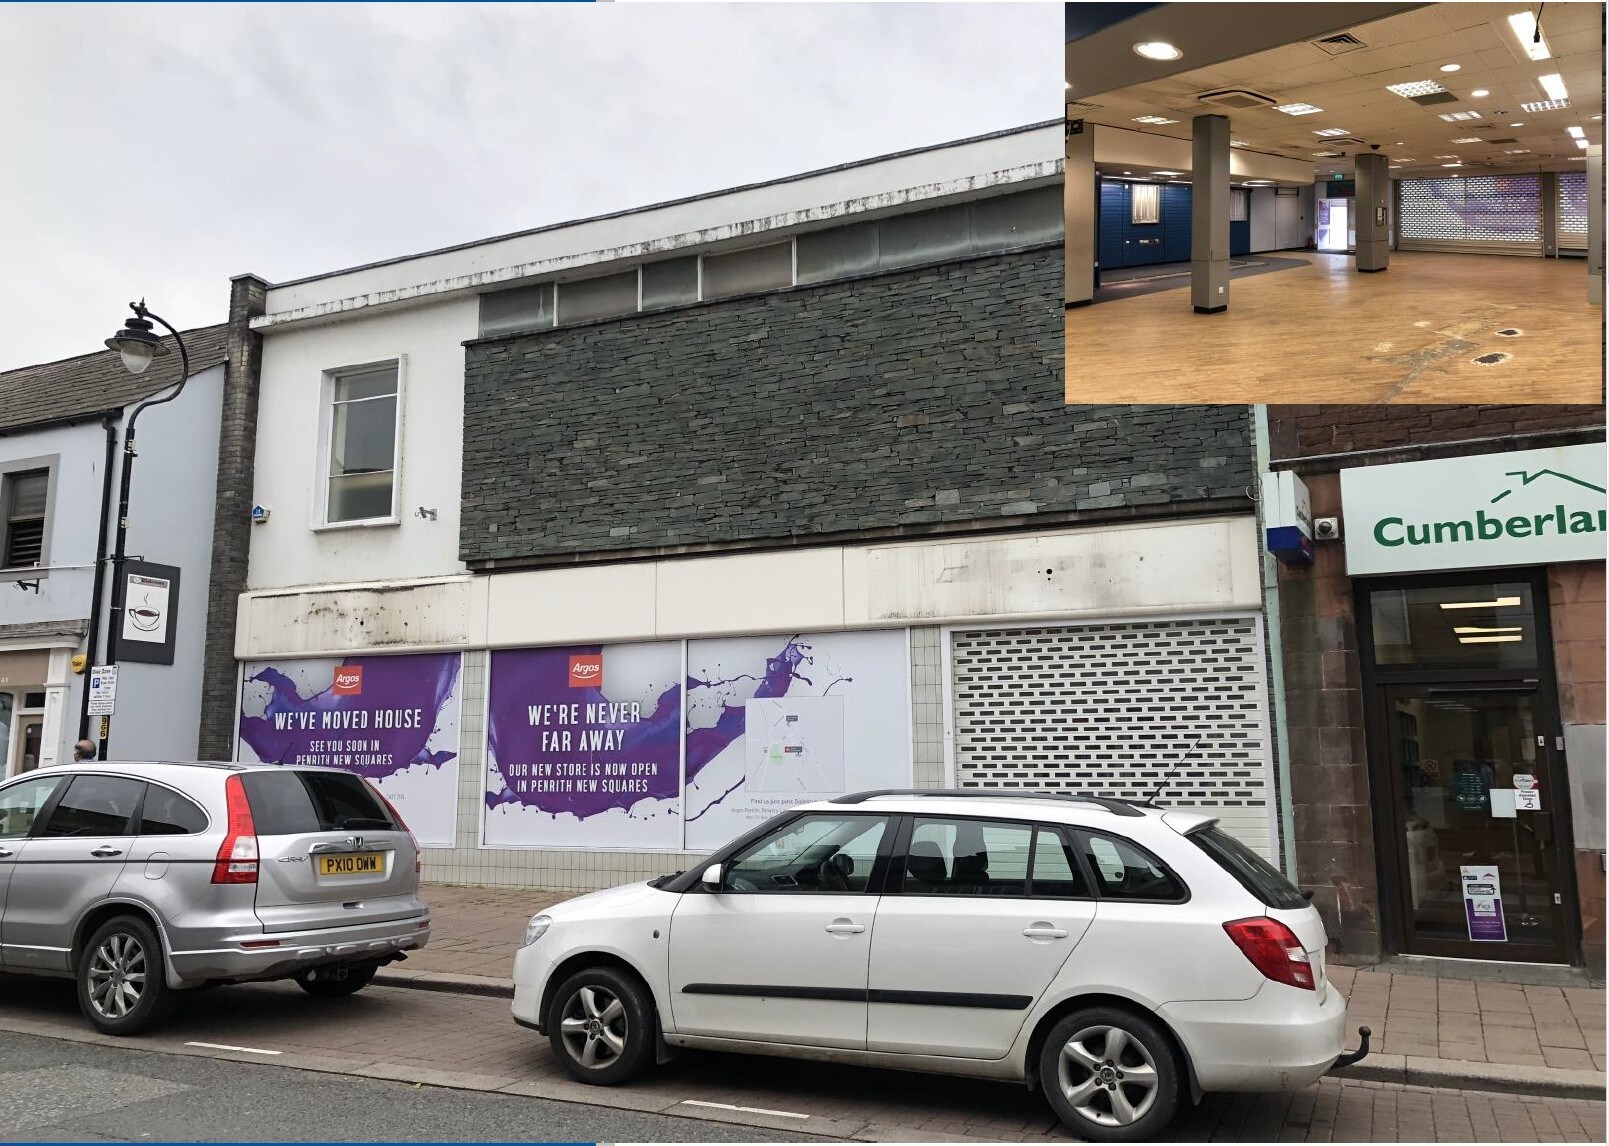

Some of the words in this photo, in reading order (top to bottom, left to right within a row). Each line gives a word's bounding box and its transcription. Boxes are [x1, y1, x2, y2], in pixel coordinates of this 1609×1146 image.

[573, 662, 600, 675] Argos
[337, 673, 360, 685] Argos
[275, 712, 316, 731] WE'VE
[322, 710, 368, 730] MOVED
[374, 708, 422, 729] HOUSE
[528, 703, 579, 726] WE'RE
[586, 701, 641, 724] NEVER
[310, 740, 324, 752] SEE
[327, 740, 343, 752] YOU
[346, 740, 368, 751] SOON
[370, 739, 380, 751] IN
[542, 730, 571, 752] FAR
[579, 729, 625, 751] AWAY
[296, 755, 330, 766] PENRITH
[333, 754, 351, 765] NEW
[355, 754, 393, 766] SQUARES
[509, 764, 528, 777] OUR
[531, 763, 552, 776] NEW
[556, 763, 587, 776] STORE
[590, 763, 600, 776] IS
[605, 763, 627, 776] NOW
[631, 762, 658, 775] OPEN
[517, 780, 527, 793] IN
[531, 780, 572, 793] PENRITH
[577, 779, 598, 792] NEW
[602, 779, 648, 793] SQUARES
[327, 857, 354, 873] PX10
[356, 856, 377, 870] OWW
